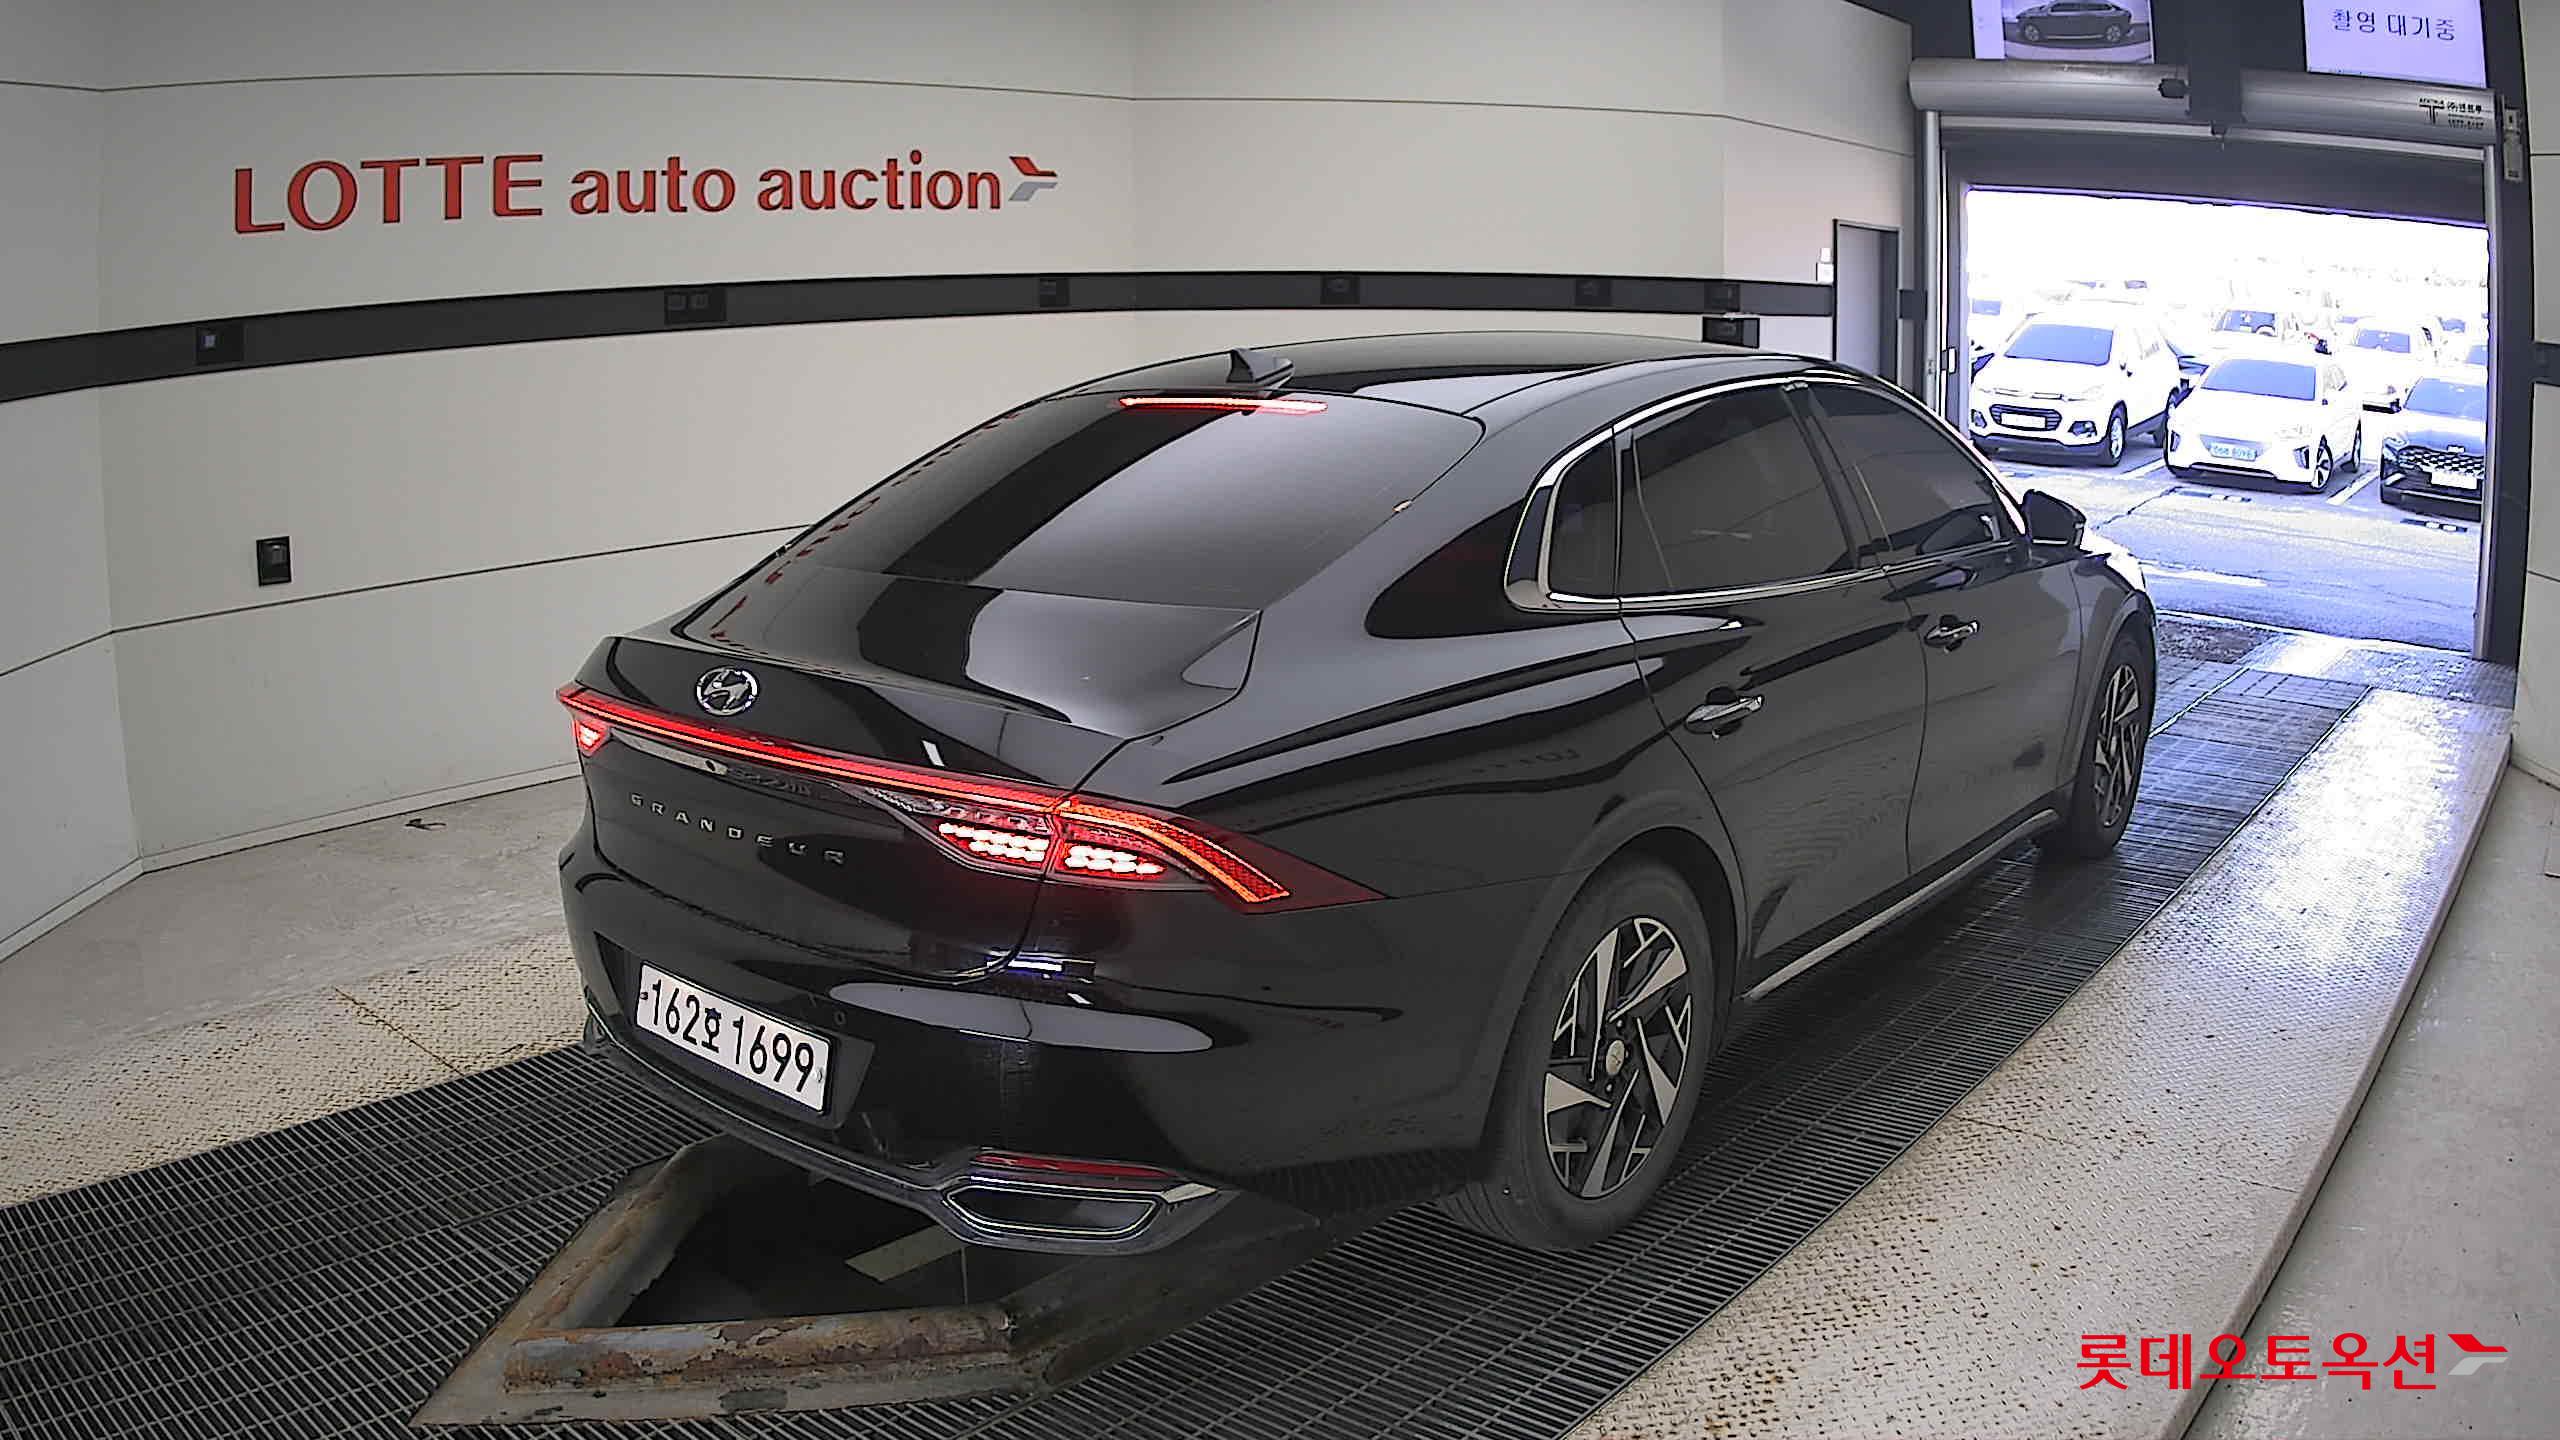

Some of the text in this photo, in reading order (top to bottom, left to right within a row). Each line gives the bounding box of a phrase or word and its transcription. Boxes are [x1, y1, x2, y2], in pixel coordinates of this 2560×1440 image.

[2332, 8, 2376, 34] 촬영
[234, 149, 1003, 236] LOTTE auto auction
[630, 793, 846, 866] GRANDEUR
